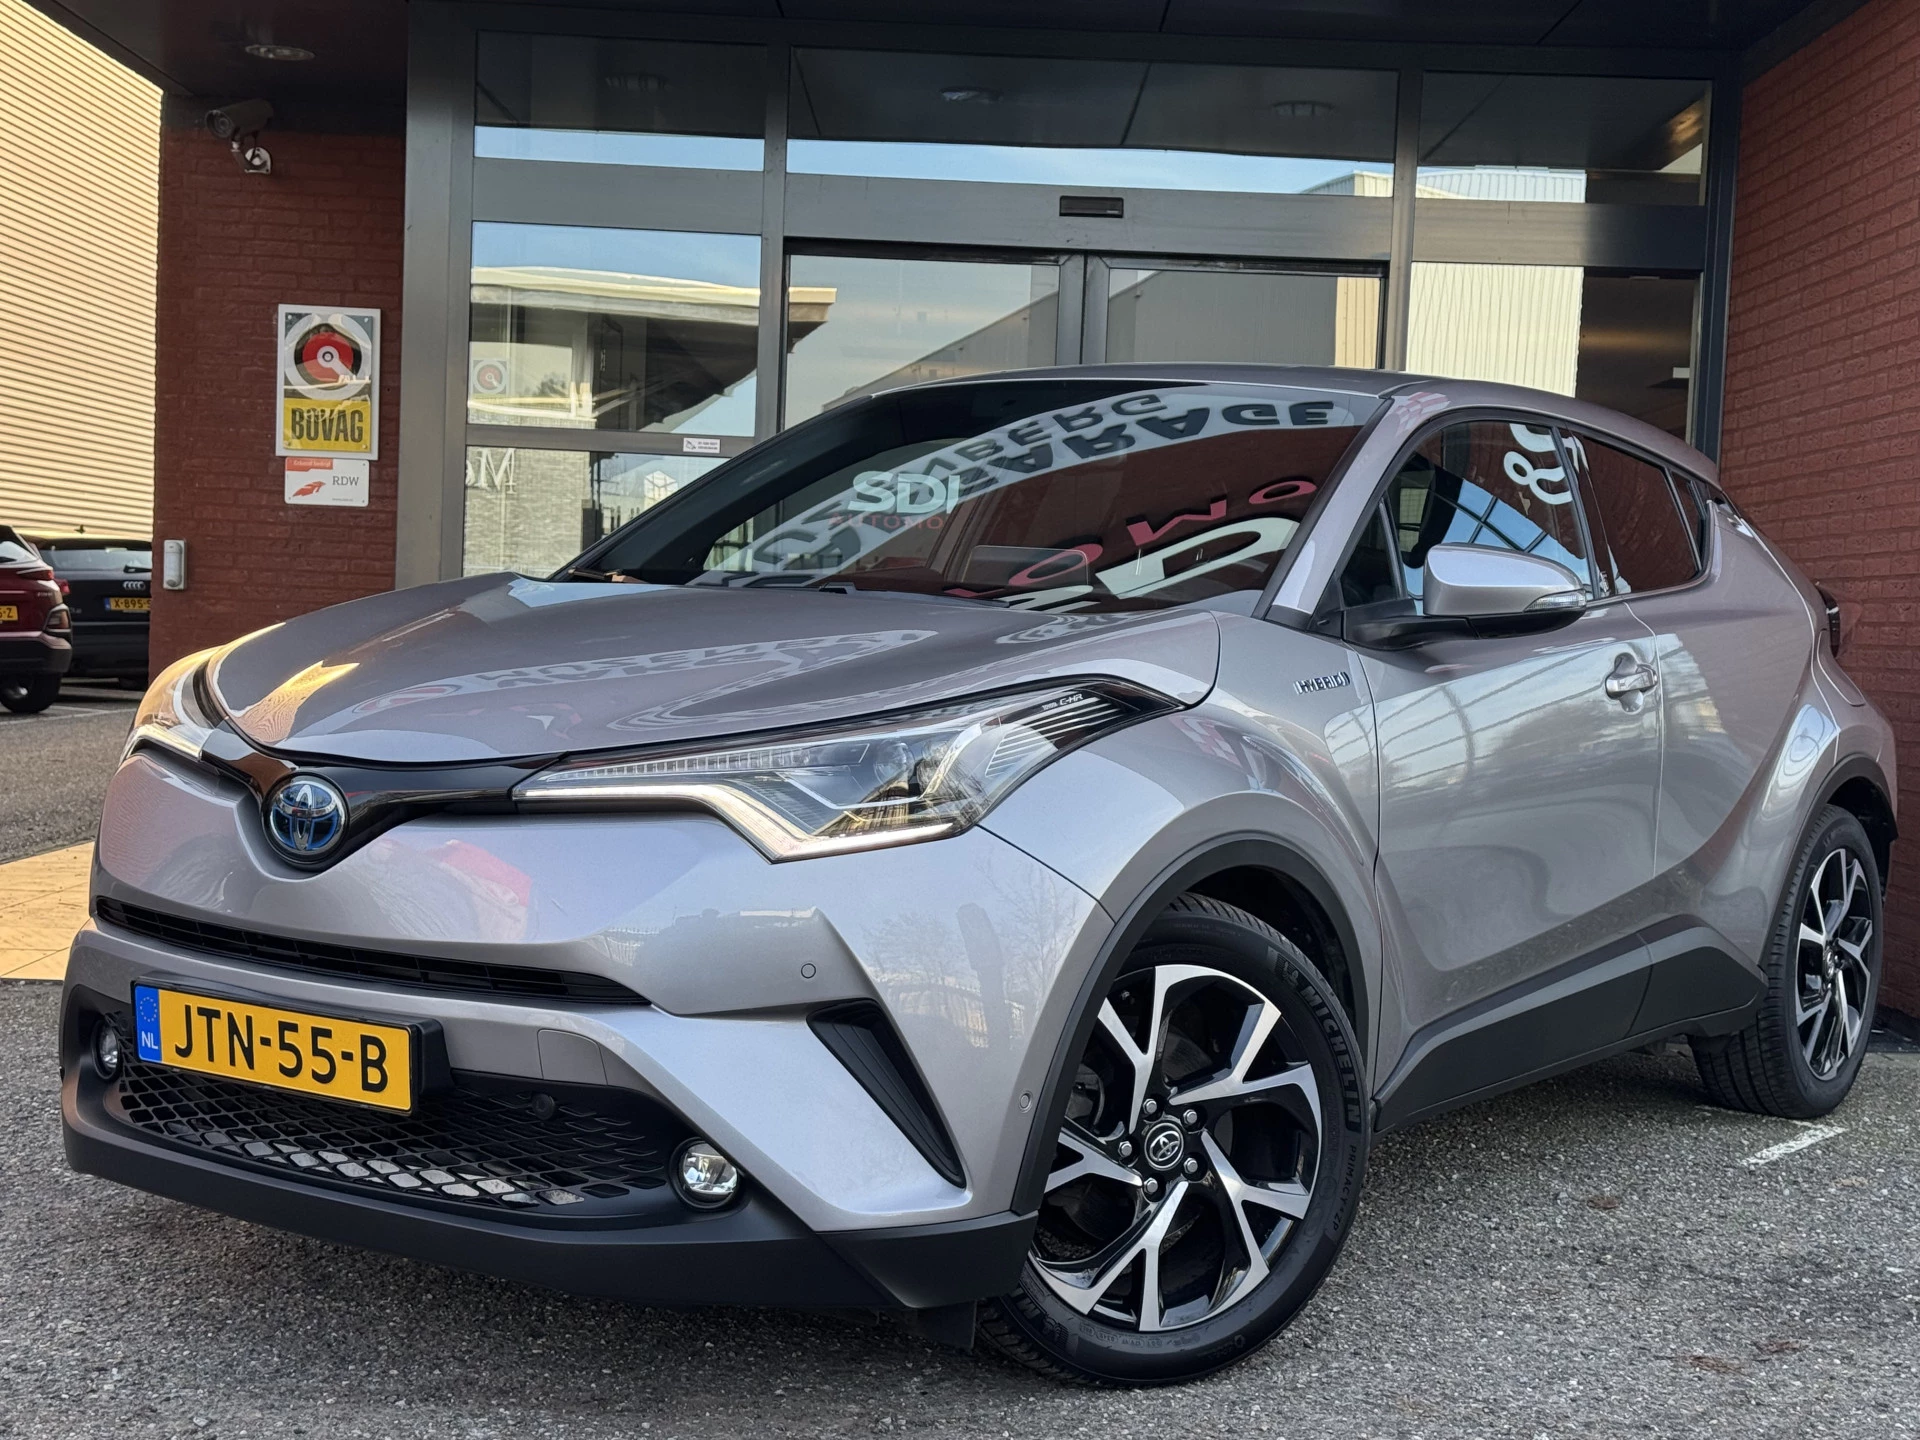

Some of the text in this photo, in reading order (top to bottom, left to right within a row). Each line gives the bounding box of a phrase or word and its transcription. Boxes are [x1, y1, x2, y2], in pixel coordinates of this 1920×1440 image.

[291, 407, 364, 443] BOVAG
[332, 475, 360, 486] RDW
[847, 470, 960, 514] SDI
[1293, 672, 1350, 694] HYBRID
[1060, 694, 1084, 705] C-HR
[141, 1031, 159, 1050] NL
[175, 1004, 389, 1093] JTN-55-B
[1300, 985, 1361, 1123] MICHELIN
